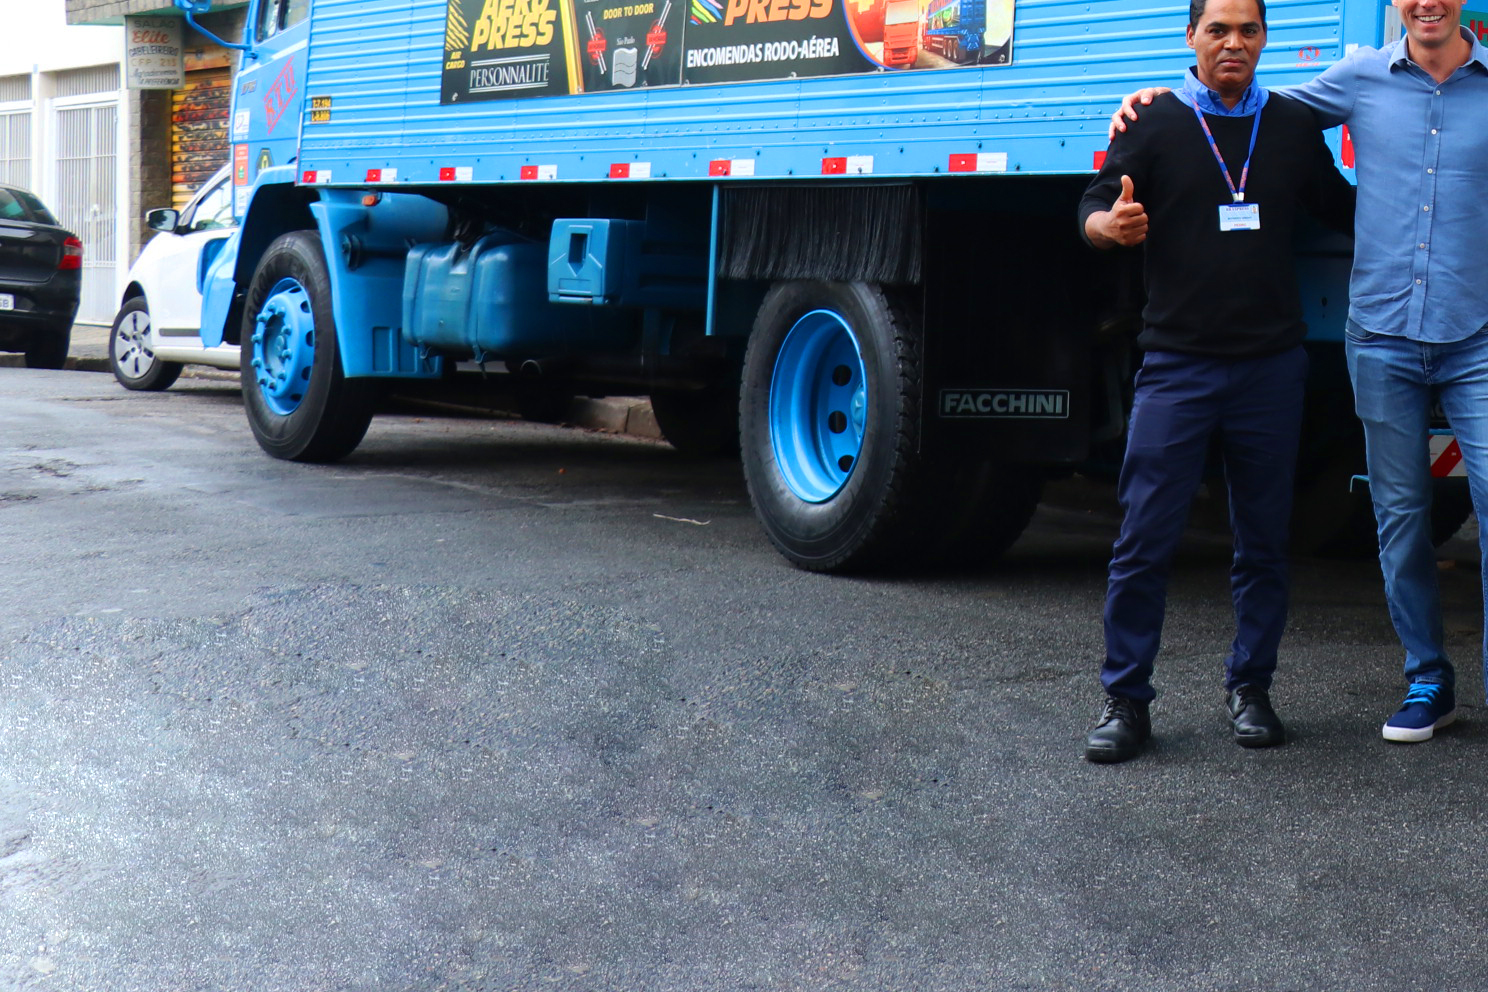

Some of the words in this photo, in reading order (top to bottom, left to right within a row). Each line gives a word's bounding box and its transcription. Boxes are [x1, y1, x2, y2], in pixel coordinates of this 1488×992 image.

[603, 8, 622, 20] DOOR
[624, 6, 634, 16] TO
[634, 3, 654, 15] DOOR
[470, 9, 557, 52] PRESS
[687, 42, 765, 68] ENCOMENDAS
[765, 34, 840, 62] RODO-AÉREA
[470, 60, 550, 88] PERSONNALITÉ
[945, 393, 1063, 414] FACCHINI
